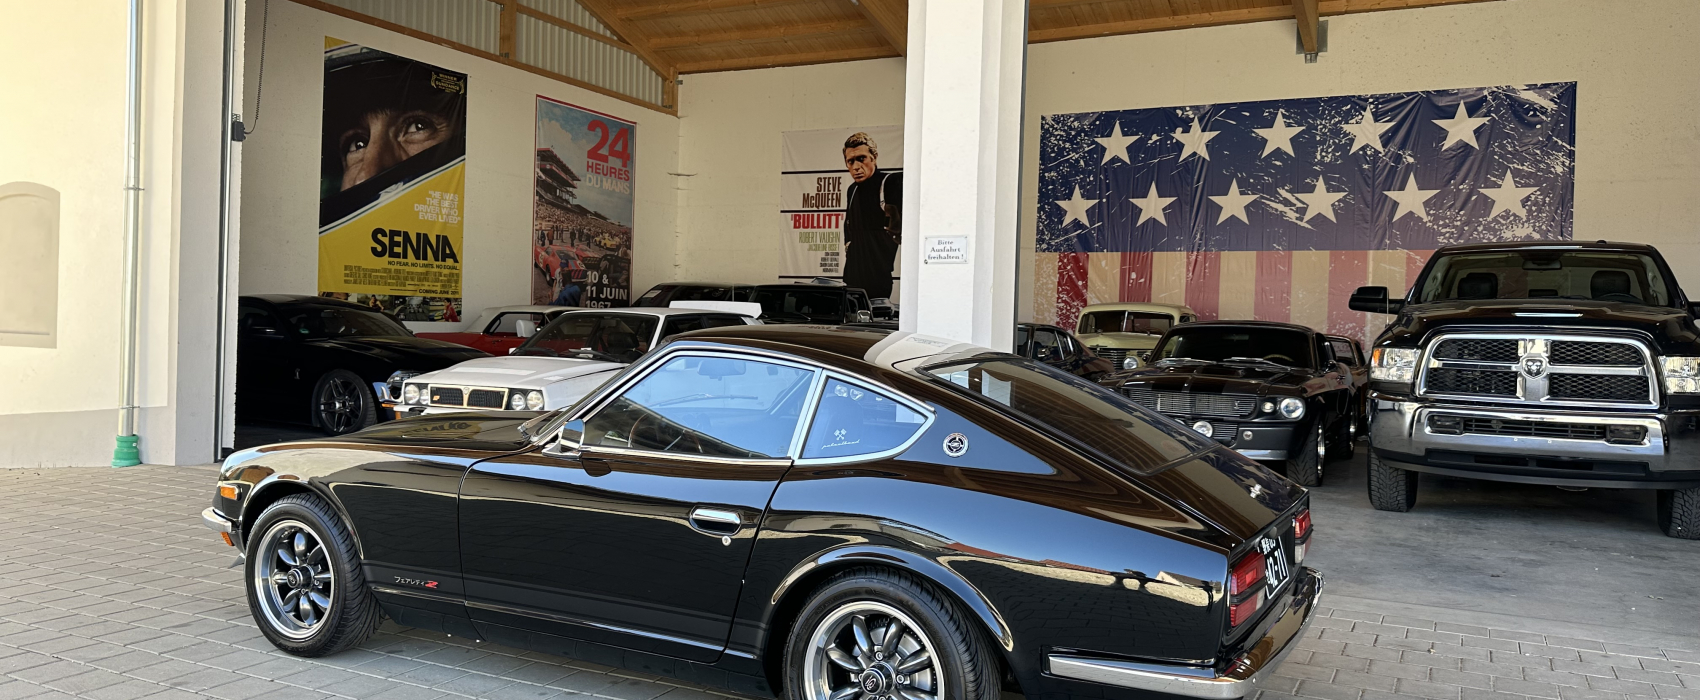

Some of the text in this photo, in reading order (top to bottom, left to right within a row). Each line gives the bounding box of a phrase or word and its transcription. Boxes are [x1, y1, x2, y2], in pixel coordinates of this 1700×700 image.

[588, 120, 630, 168] 24
[586, 160, 630, 180] HEURES
[586, 174, 630, 194] DU MANS
[816, 176, 842, 192] STEVE
[426, 198, 458, 208] THE BEST
[444, 192, 458, 200] WAS
[802, 193, 841, 209] McQUEEN
[414, 204, 458, 216] DRIVER WHO
[419, 212, 438, 221] EVER
[790, 214, 844, 228] 'BULLITT'
[798, 232, 840, 244] ROBERT VAUGHN
[371, 228, 459, 263] SENNA
[586, 270, 608, 284] 10 &
[586, 286, 628, 300] 11 JUIN
